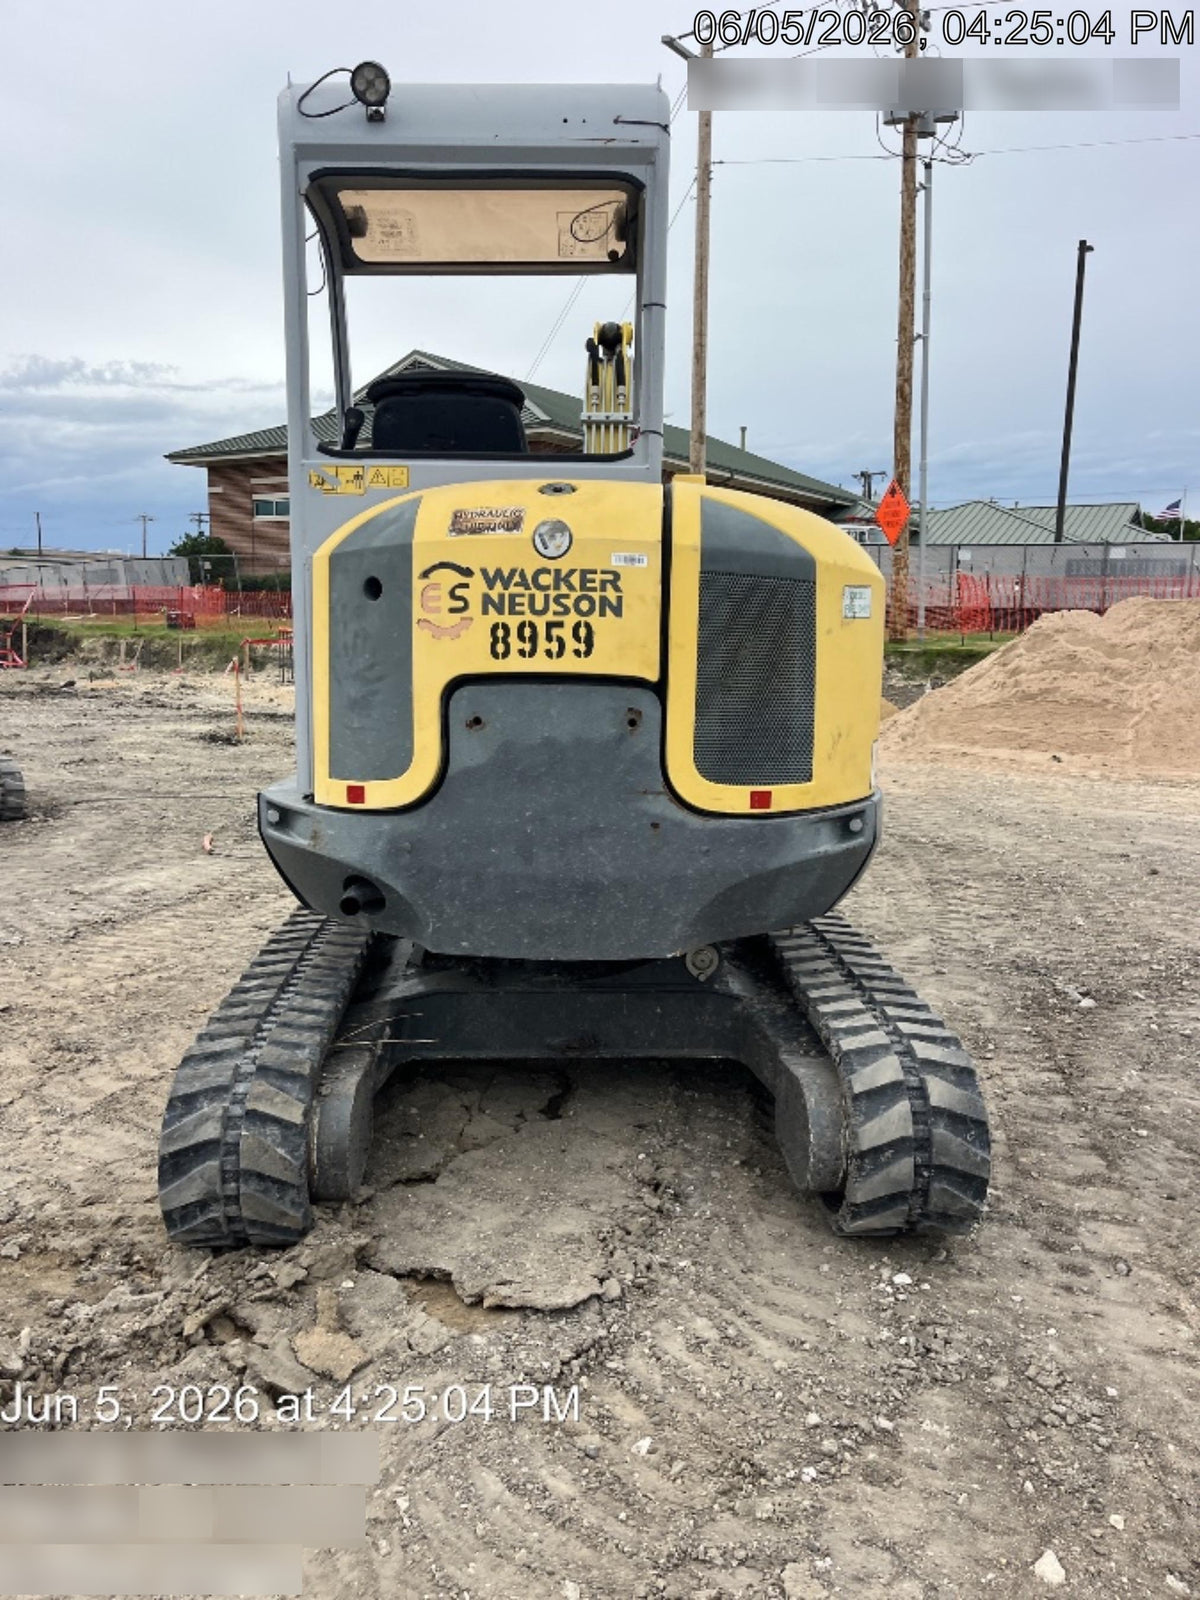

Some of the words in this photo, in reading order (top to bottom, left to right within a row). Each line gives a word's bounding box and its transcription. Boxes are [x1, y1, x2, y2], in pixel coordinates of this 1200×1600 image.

[480, 567, 623, 593] WACKER
[481, 593, 623, 618] NEUSON
[489, 620, 595, 660] 8959
